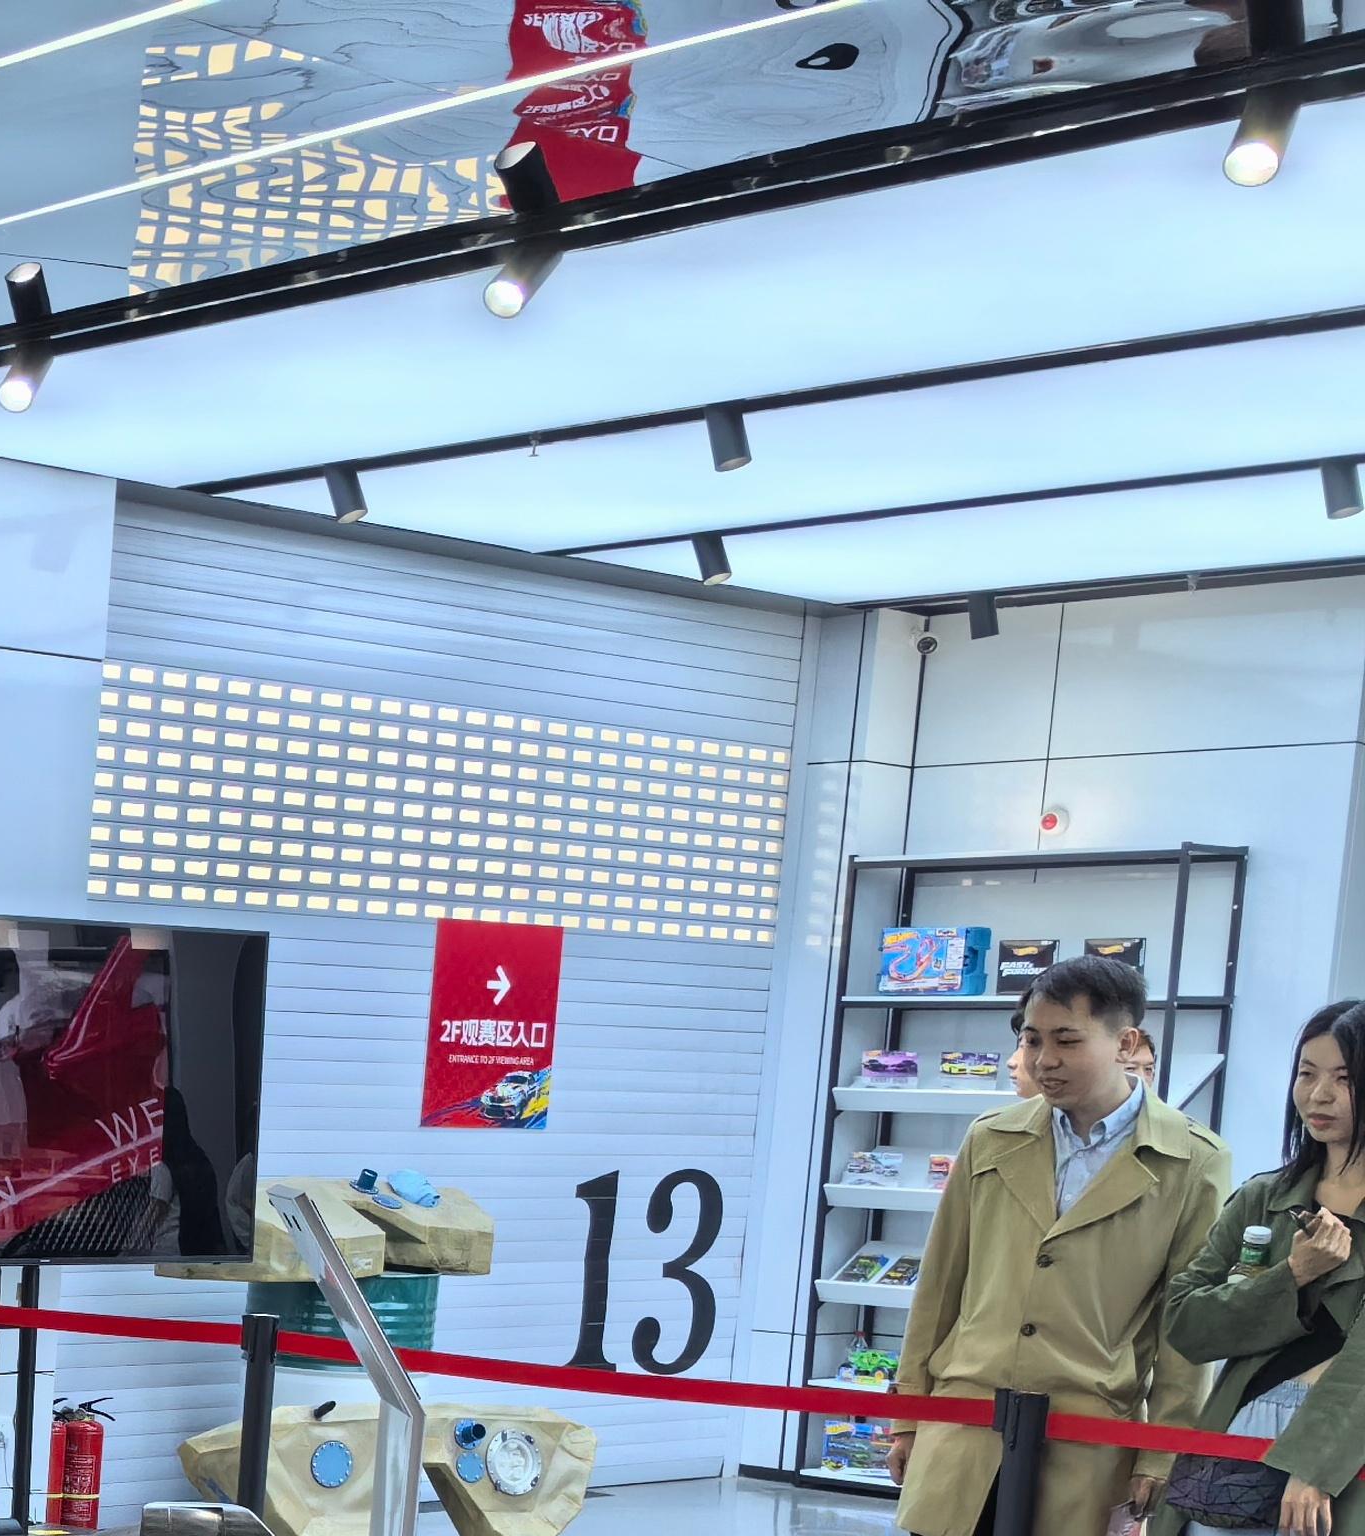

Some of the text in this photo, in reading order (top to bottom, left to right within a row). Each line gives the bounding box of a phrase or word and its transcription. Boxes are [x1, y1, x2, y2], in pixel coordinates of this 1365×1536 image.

[440, 1019, 547, 1048] 2F观赛区入口
[448, 1054, 480, 1064] ENTRANCE
[519, 1058, 534, 1066] AREA
[566, 1167, 724, 1376] 13
